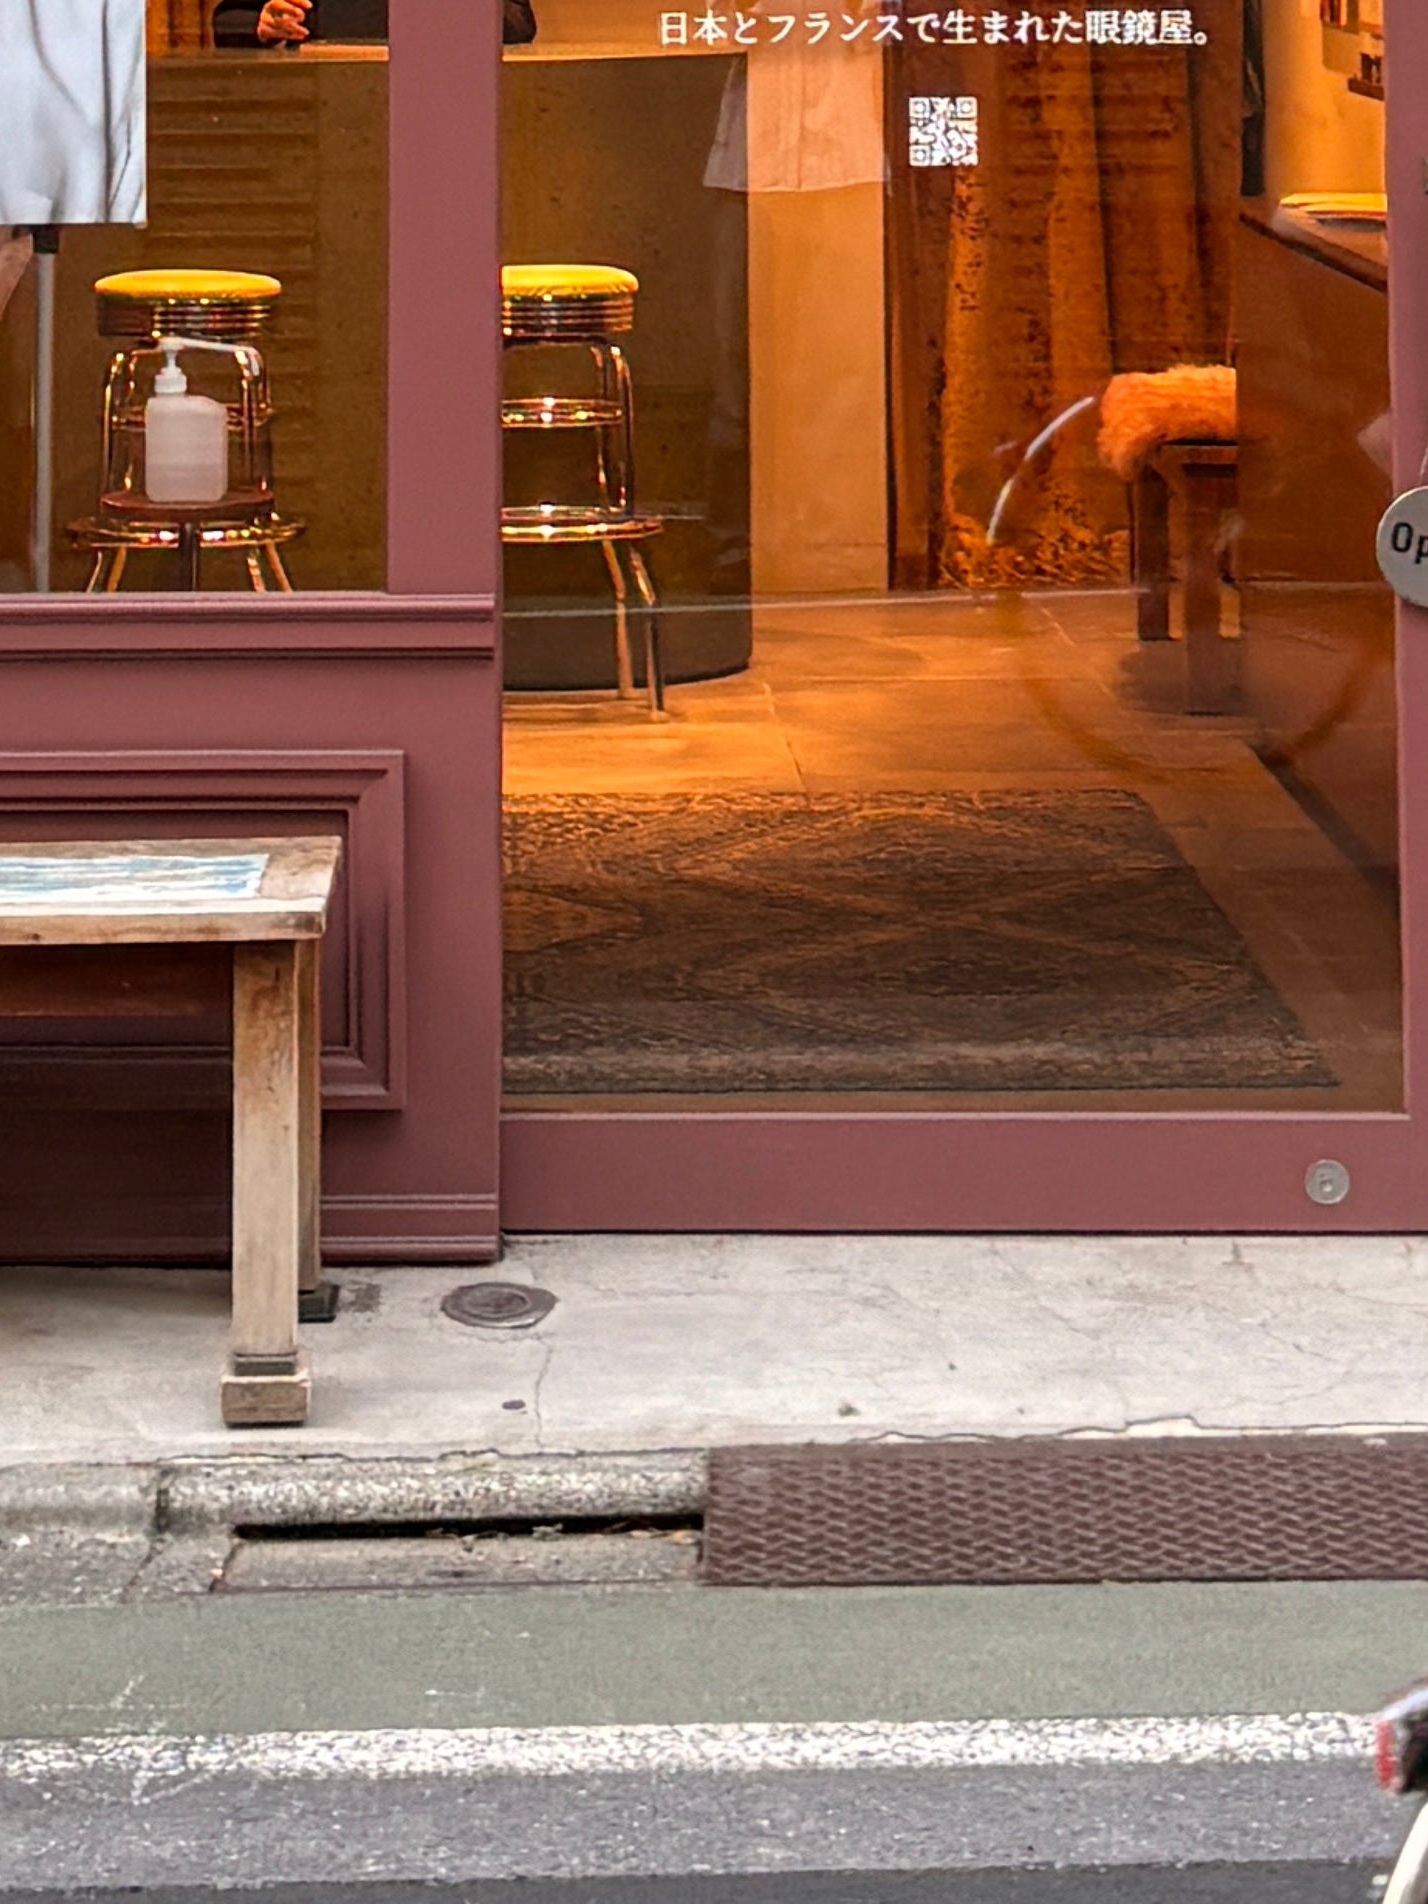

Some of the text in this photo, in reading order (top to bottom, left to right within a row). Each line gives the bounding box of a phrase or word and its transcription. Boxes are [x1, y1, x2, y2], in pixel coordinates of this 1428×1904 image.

[660, 8, 1210, 47] 日本とフランスで生まれた眼鏡屋。
